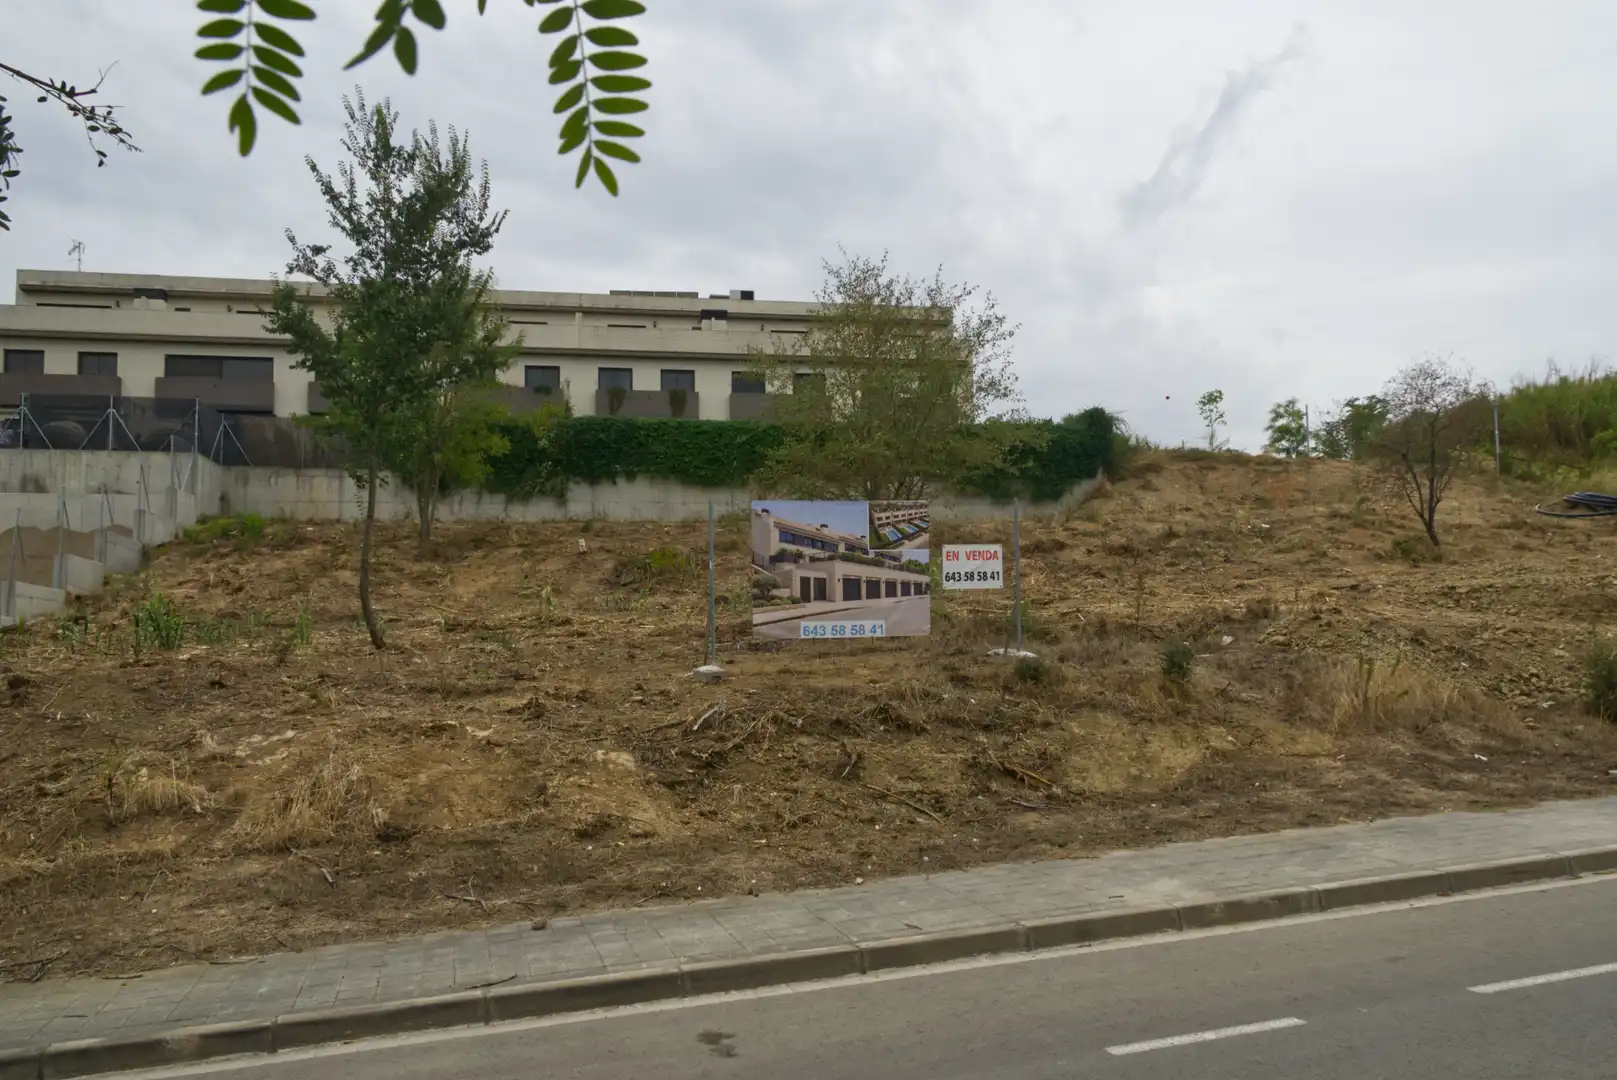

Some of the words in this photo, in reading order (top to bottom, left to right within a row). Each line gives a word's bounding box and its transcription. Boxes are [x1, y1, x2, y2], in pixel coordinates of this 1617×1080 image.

[945, 550, 960, 561] EN
[965, 550, 999, 561] VENDA
[944, 571, 962, 582] 643
[963, 571, 975, 582] 58
[977, 571, 988, 581] 58
[989, 571, 1000, 581] 41
[803, 624, 826, 636] 643
[831, 624, 846, 636] 58
[850, 624, 866, 636] 58
[869, 624, 884, 635] 41
